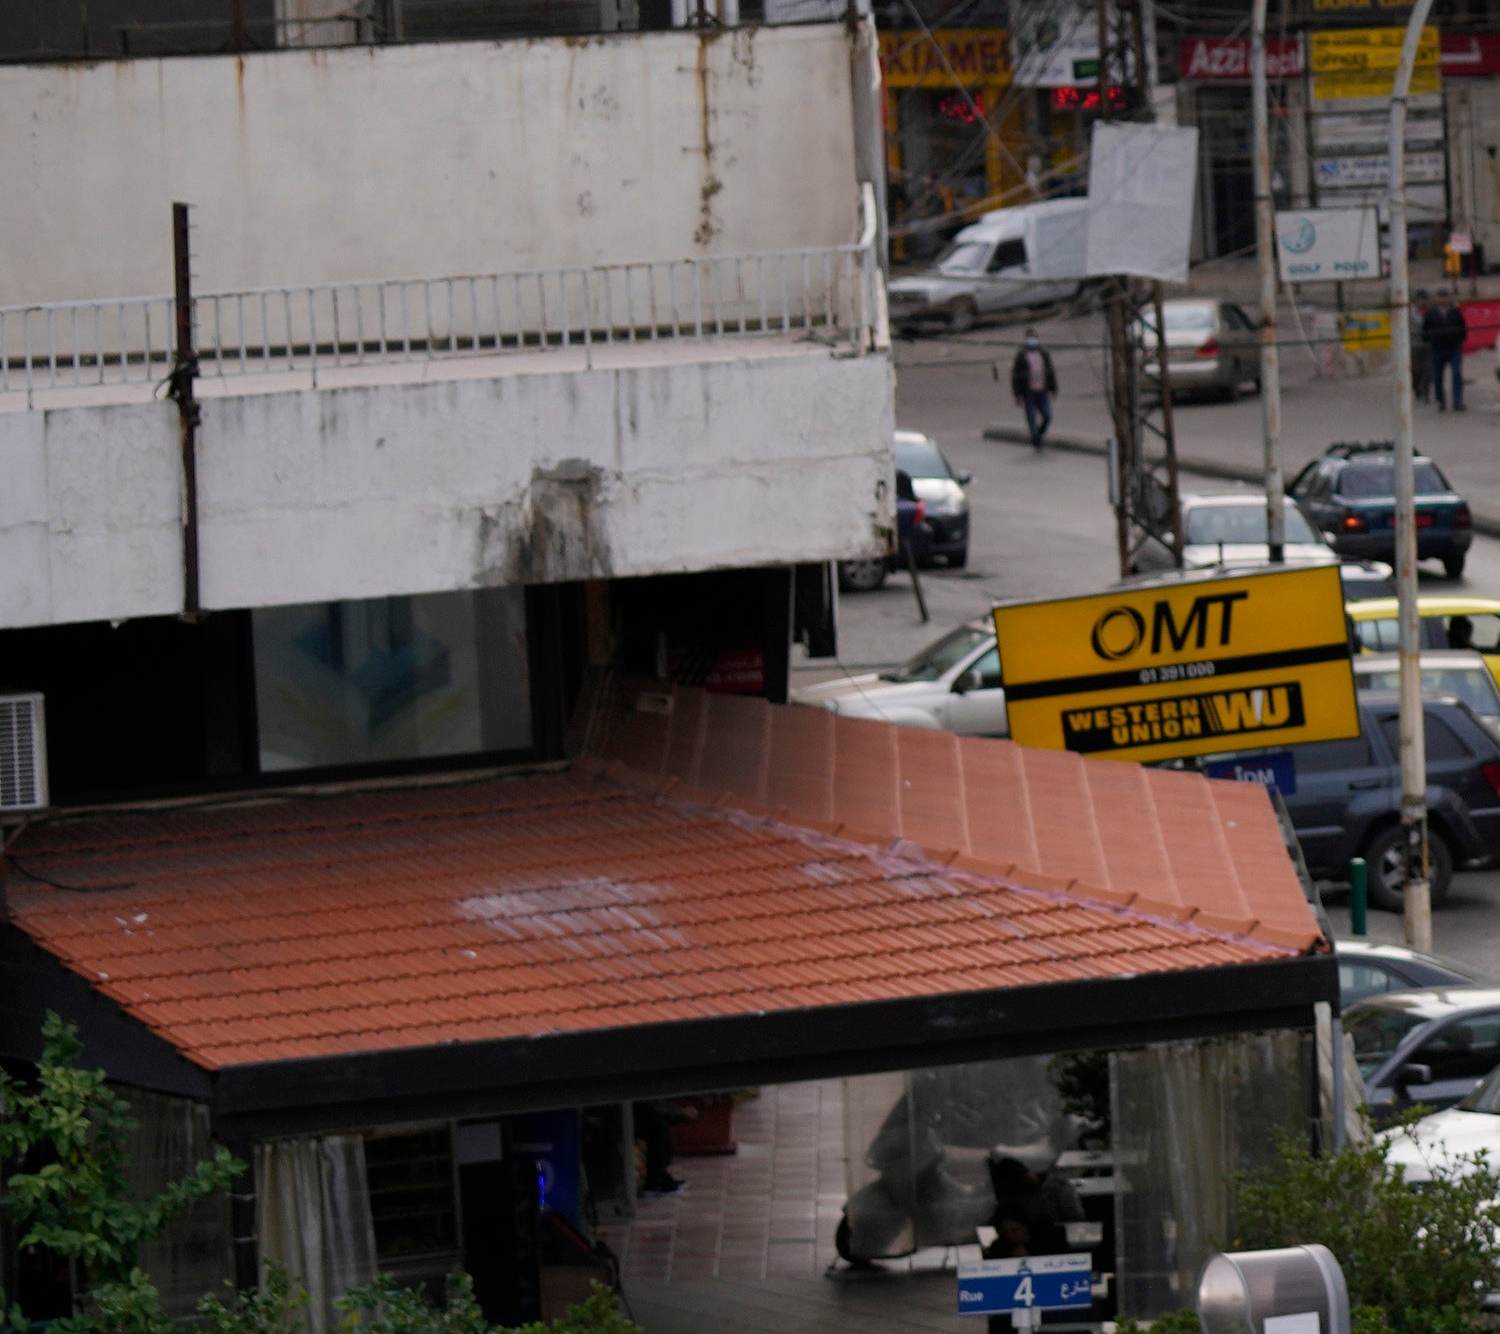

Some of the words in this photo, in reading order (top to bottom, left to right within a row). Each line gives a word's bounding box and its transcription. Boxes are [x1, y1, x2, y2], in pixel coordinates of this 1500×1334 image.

[1090, 589, 1249, 662] OMT
[1067, 697, 1200, 733] WESTERN
[1112, 716, 1202, 746] UNION
[1013, 1276, 1036, 1306] 4
